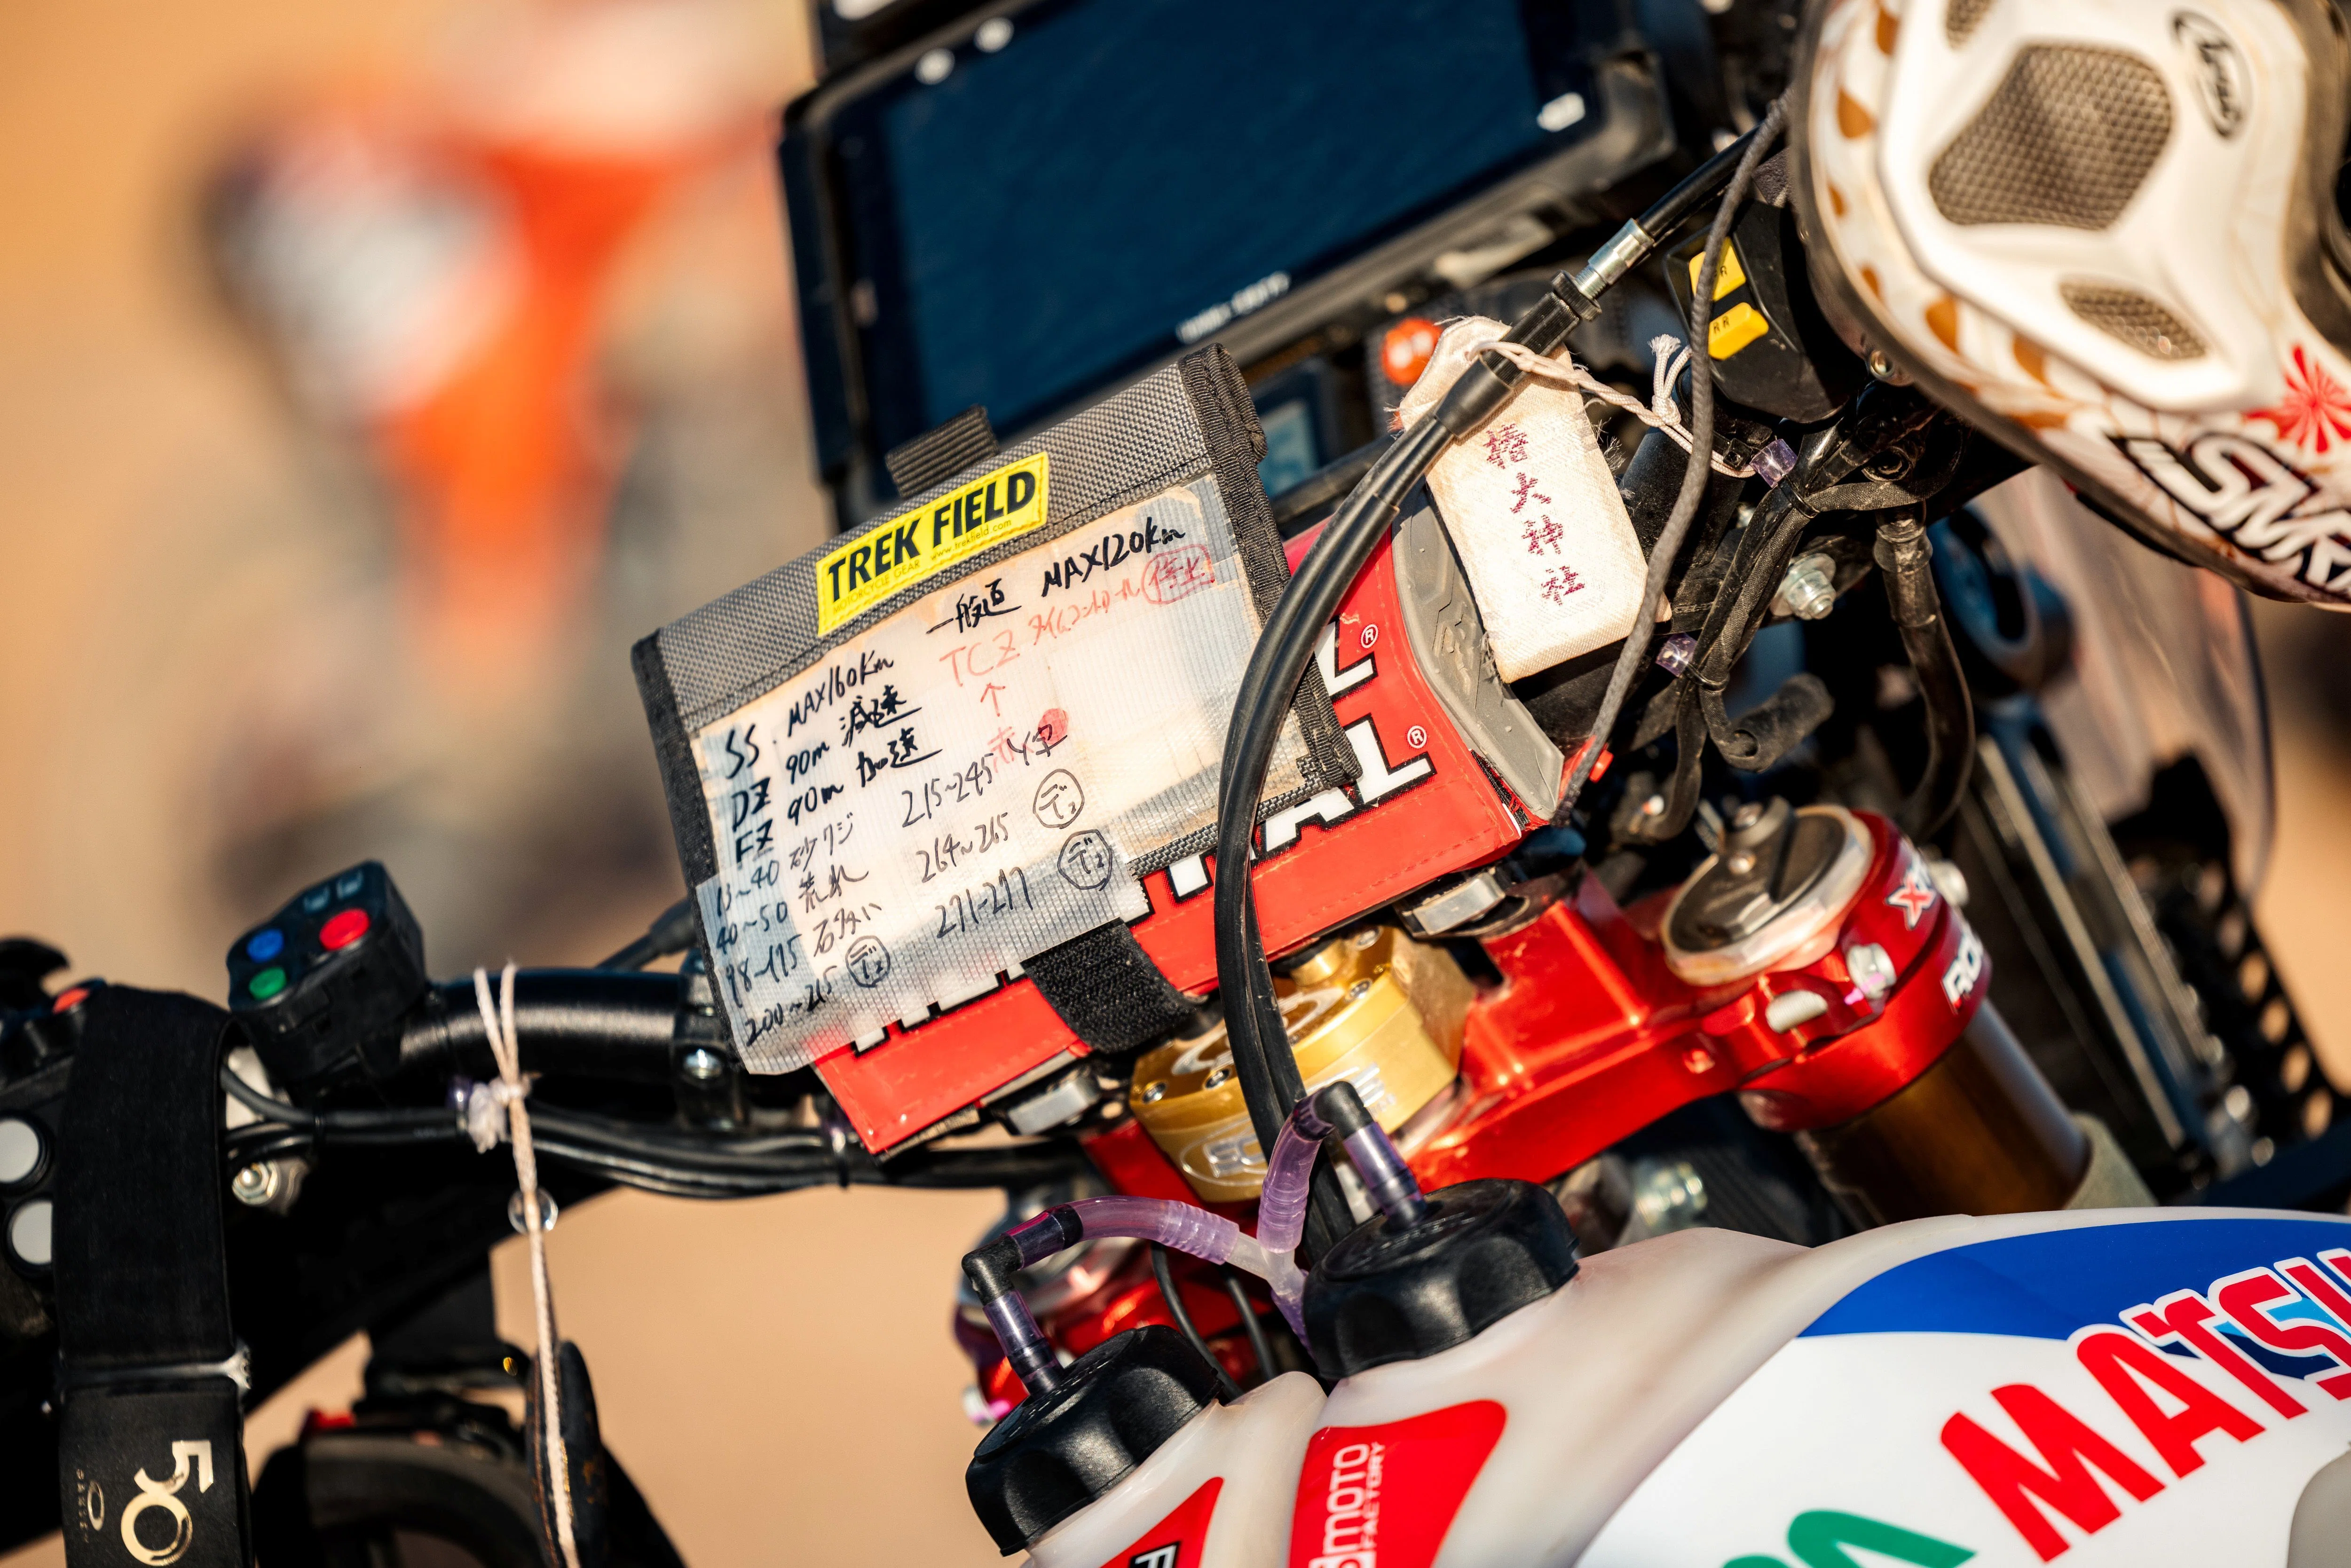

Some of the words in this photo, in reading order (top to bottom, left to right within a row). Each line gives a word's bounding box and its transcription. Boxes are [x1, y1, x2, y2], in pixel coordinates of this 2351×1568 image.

[828, 517, 921, 602] TREK
[933, 471, 1035, 548] FIELD
[833, 576, 890, 614] MOTORCYCLE
[894, 559, 920, 577] GEAR
[931, 519, 1011, 561] www.trekfield.com
